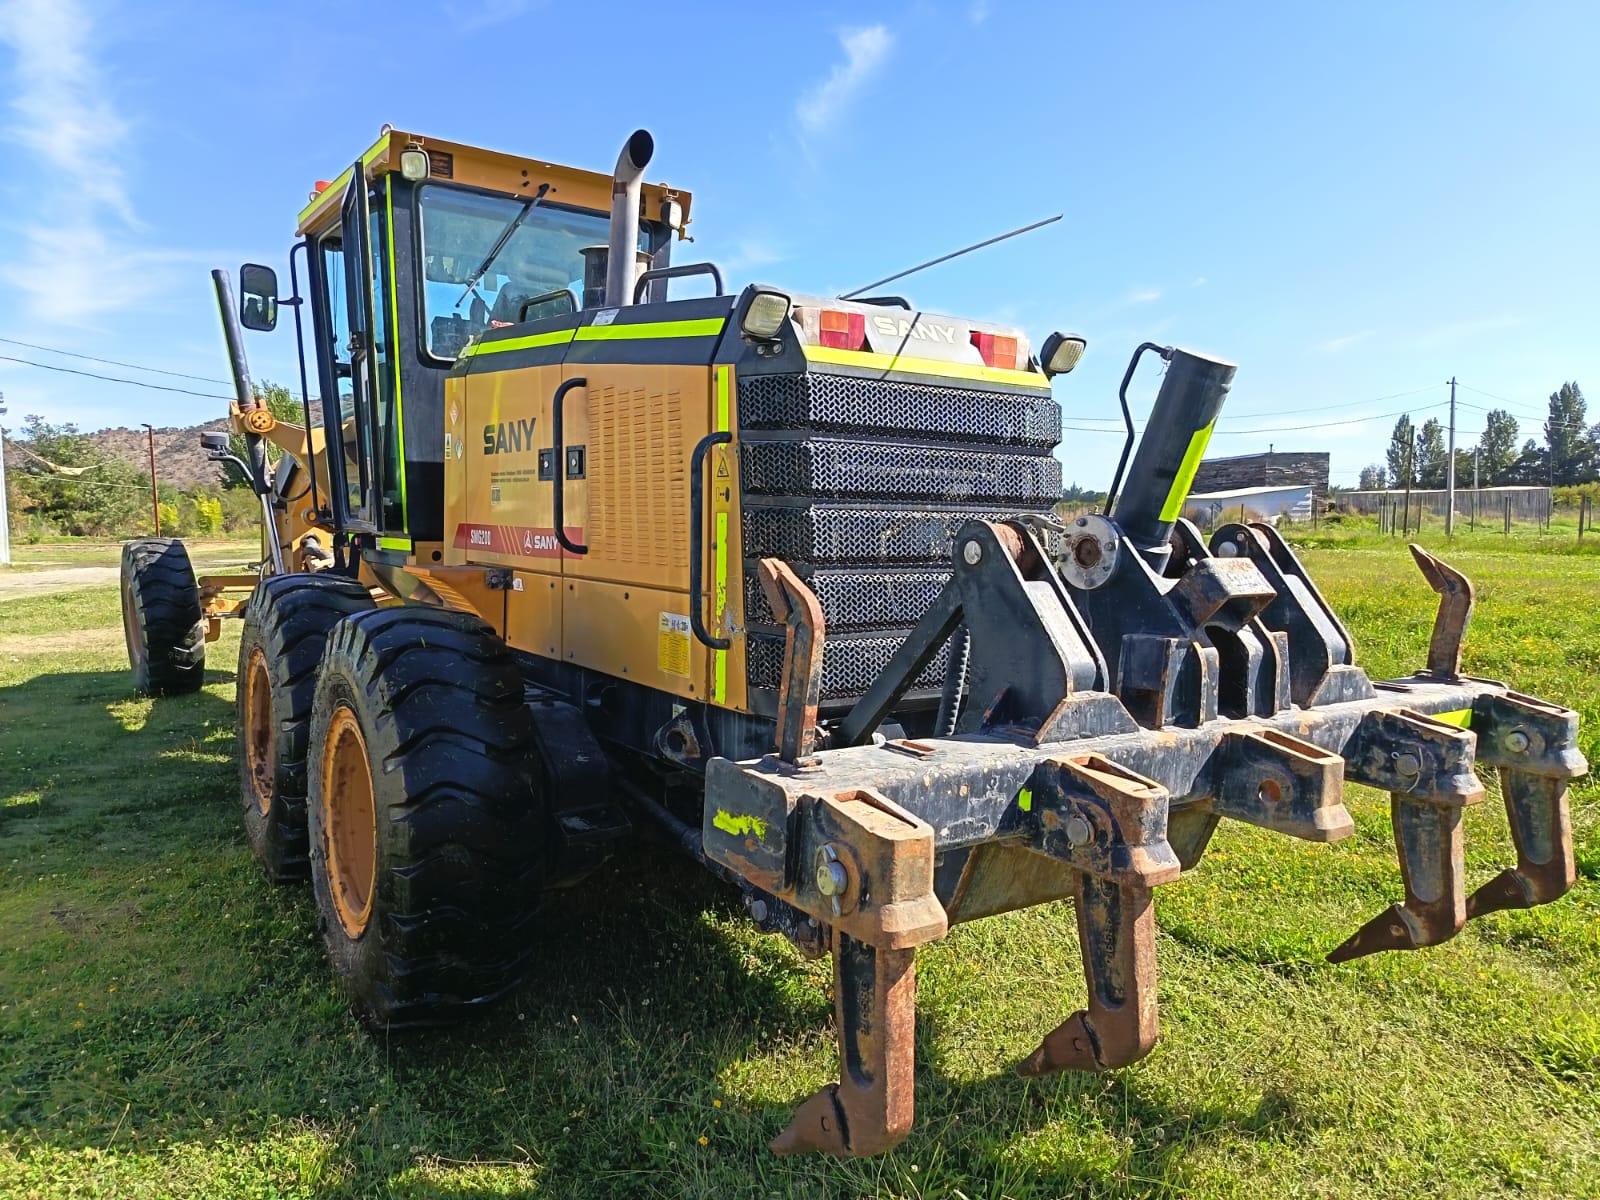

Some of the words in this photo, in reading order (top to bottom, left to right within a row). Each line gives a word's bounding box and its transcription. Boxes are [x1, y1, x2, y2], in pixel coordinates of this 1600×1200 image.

[873, 315, 955, 344] SANY
[484, 417, 536, 455] SANY
[470, 529, 491, 546] SMG200
[534, 535, 558, 550] SANY
